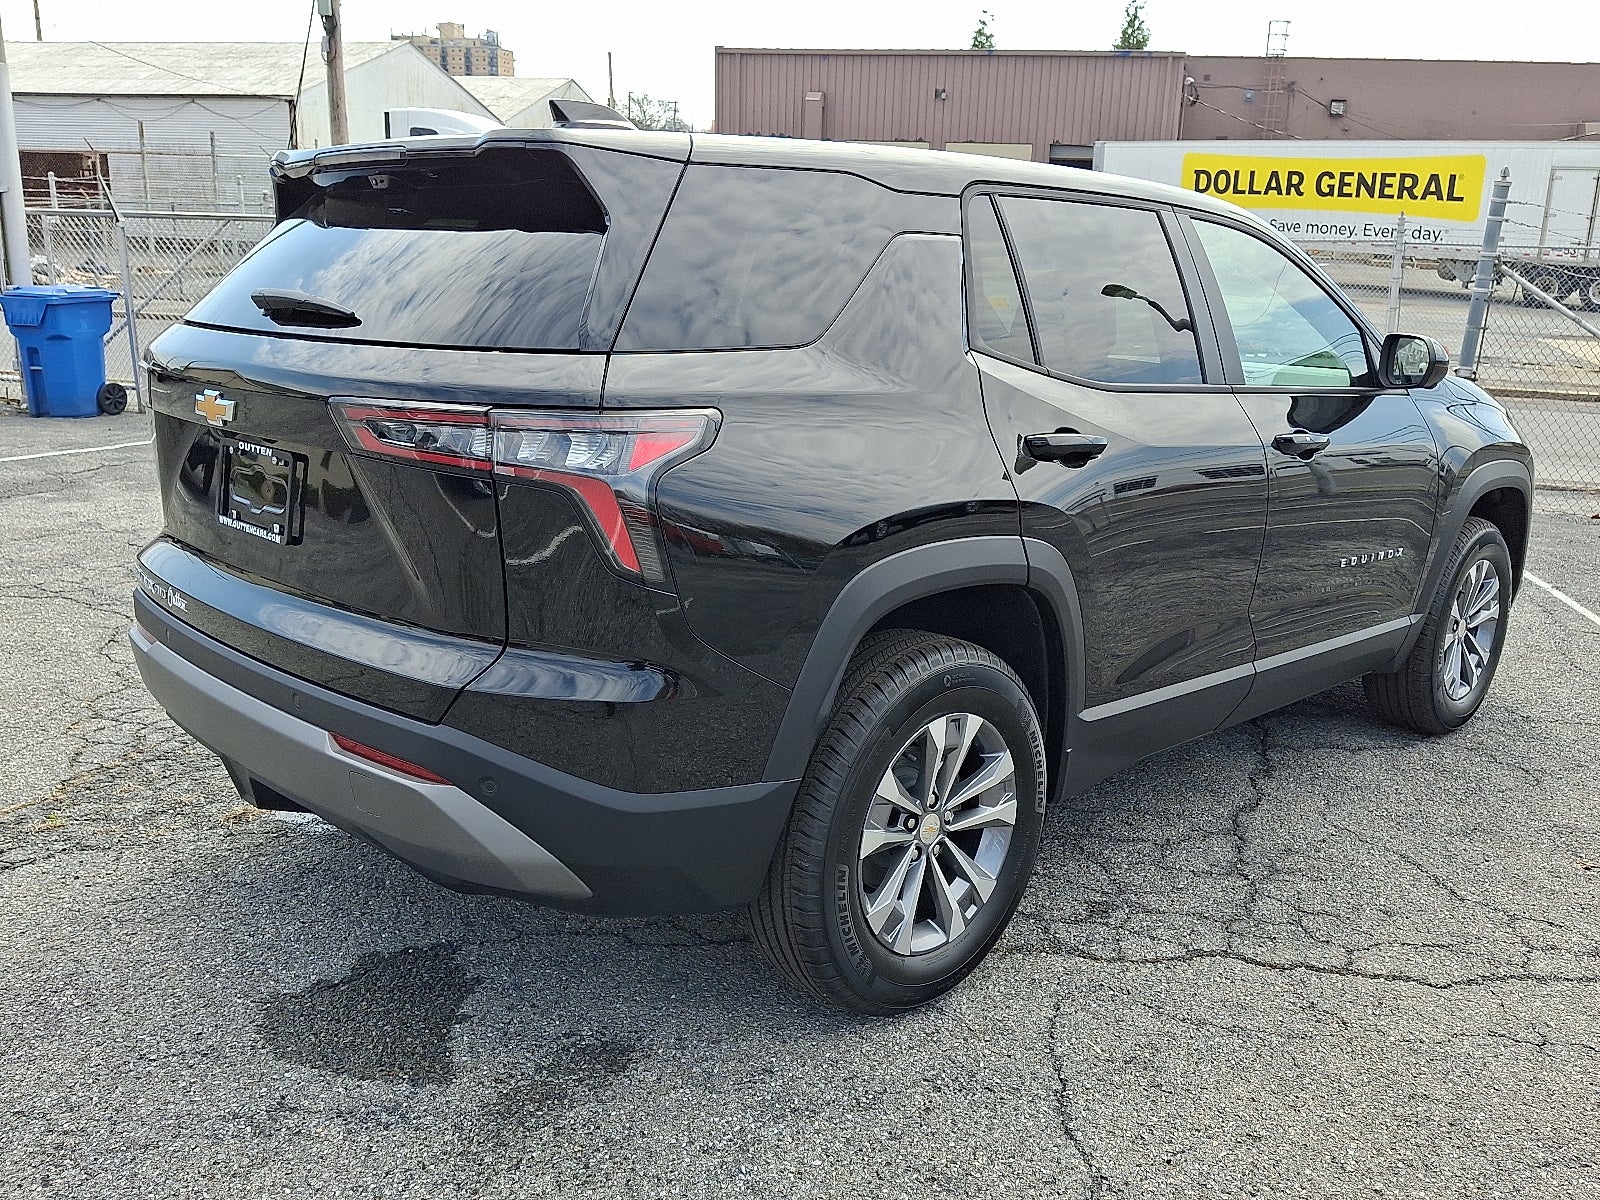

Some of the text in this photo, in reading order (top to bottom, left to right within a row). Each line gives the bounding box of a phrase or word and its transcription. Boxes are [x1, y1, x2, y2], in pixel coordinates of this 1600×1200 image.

[1193, 169, 1465, 202] DOLLAR GENERAL
[1269, 218, 1444, 242] Save money. Ever day.
[238, 441, 273, 457] OUTTEN
[219, 515, 281, 544] WWW.OUTTENCARS.COM
[1340, 547, 1404, 568] EQUINOX
[1029, 730, 1044, 809] MICHELIN
[837, 868, 860, 957] MICHELIN
